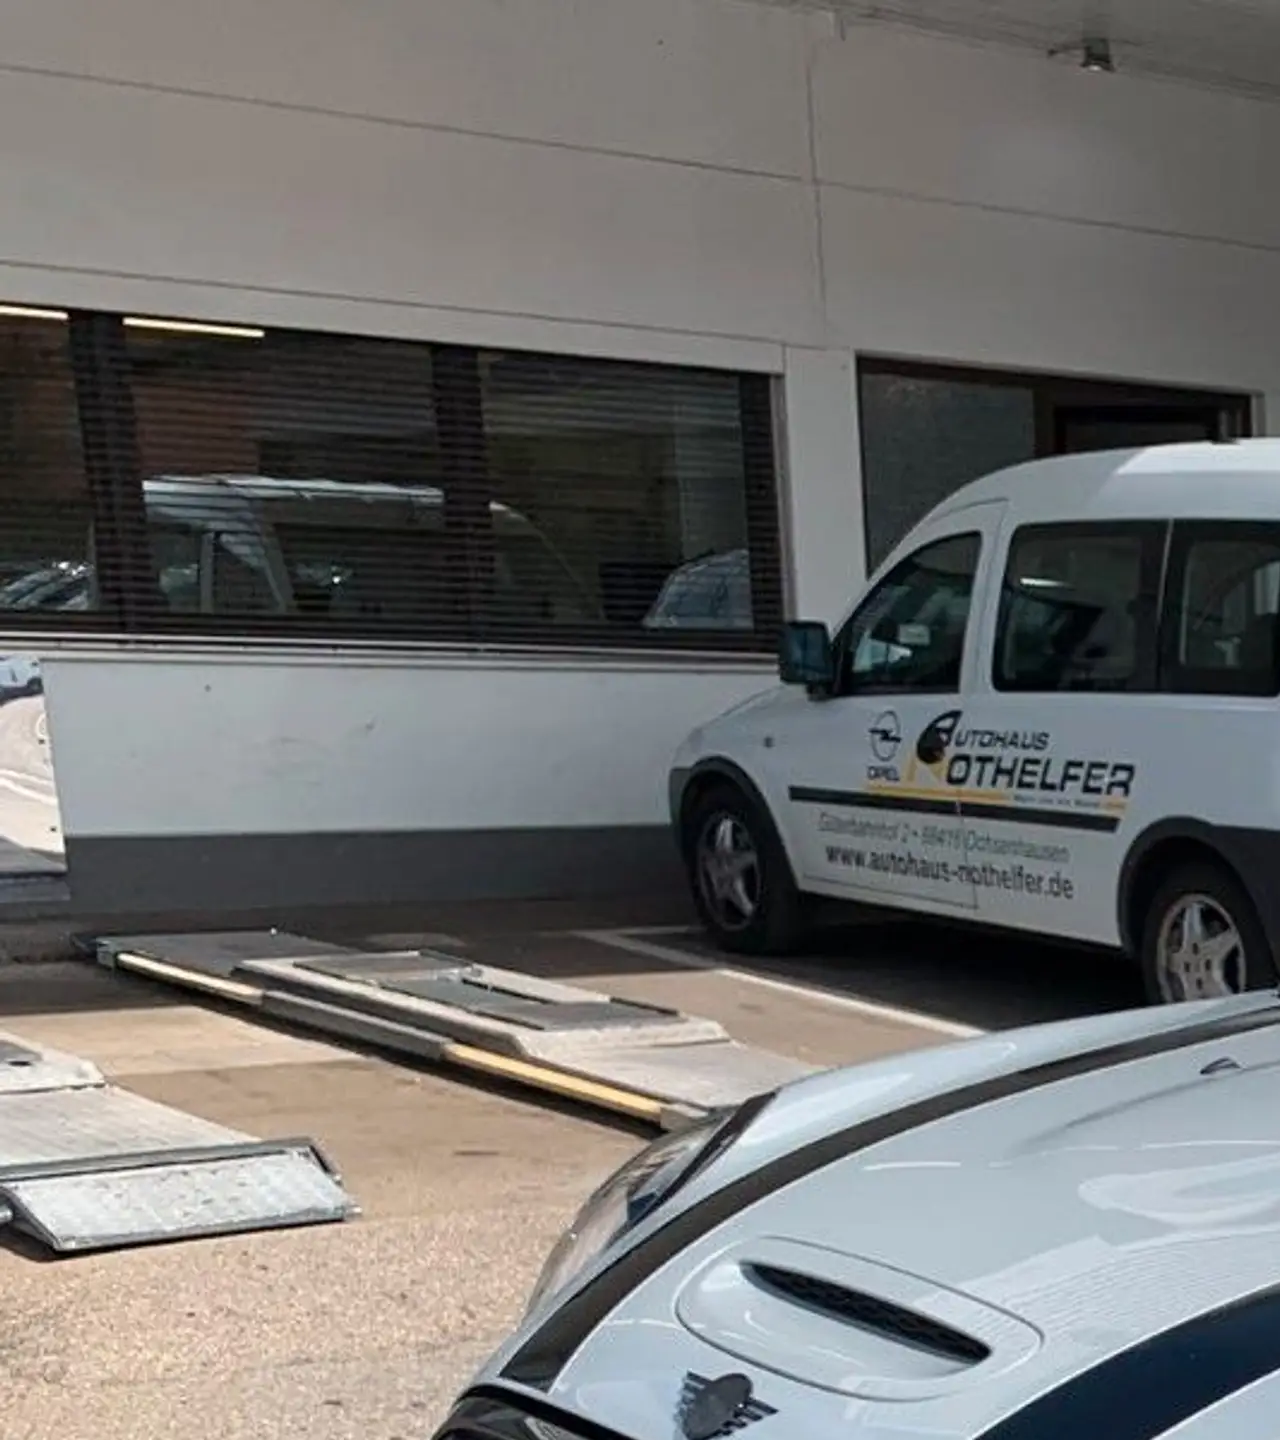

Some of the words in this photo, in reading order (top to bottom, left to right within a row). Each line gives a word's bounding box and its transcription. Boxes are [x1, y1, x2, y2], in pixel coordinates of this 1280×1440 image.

[916, 710, 1051, 764] AUTOHAUS
[866, 766, 899, 782] OPEL
[825, 846, 1074, 899] www.autohaus-nothelfer.de
